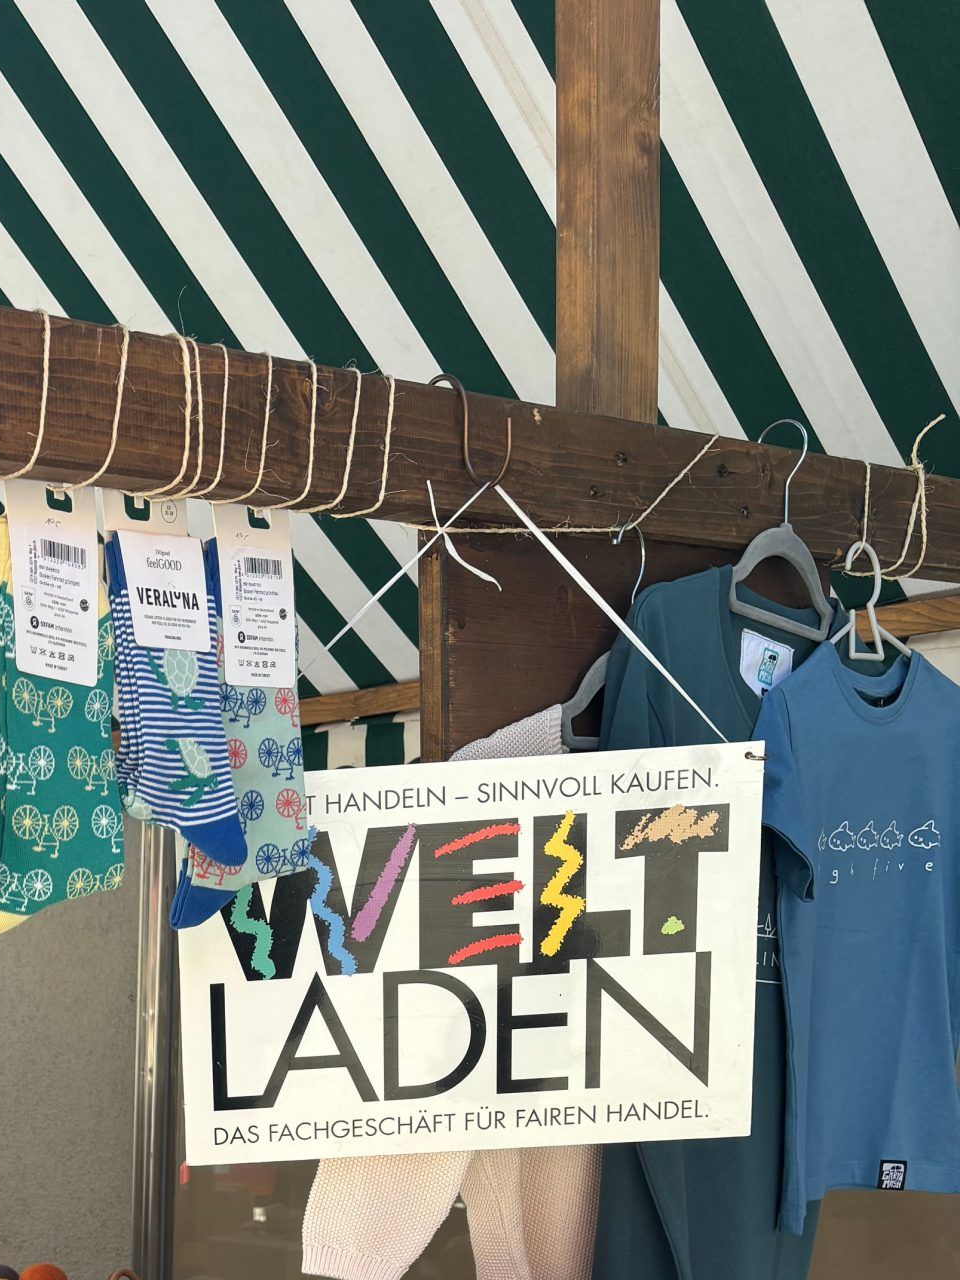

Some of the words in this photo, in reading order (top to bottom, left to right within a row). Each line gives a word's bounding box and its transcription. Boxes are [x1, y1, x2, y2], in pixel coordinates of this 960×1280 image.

[146, 557, 182, 572] feelGOOD
[136, 586, 200, 611] VERALUNA
[40, 621, 54, 629] OXFAM
[325, 786, 446, 814] HANDELN
[477, 775, 603, 803] SINNVOLL
[610, 767, 719, 794] KAUFEN.
[873, 858, 934, 880] five
[220, 803, 730, 981] WELT
[210, 951, 712, 1111] LADEN
[213, 1125, 259, 1147] DAS
[268, 1109, 455, 1144] FACHGESCHÄFT
[464, 1106, 506, 1131] FÜR
[515, 1106, 597, 1130] FAIREN
[607, 1099, 709, 1123] HANDEL.
